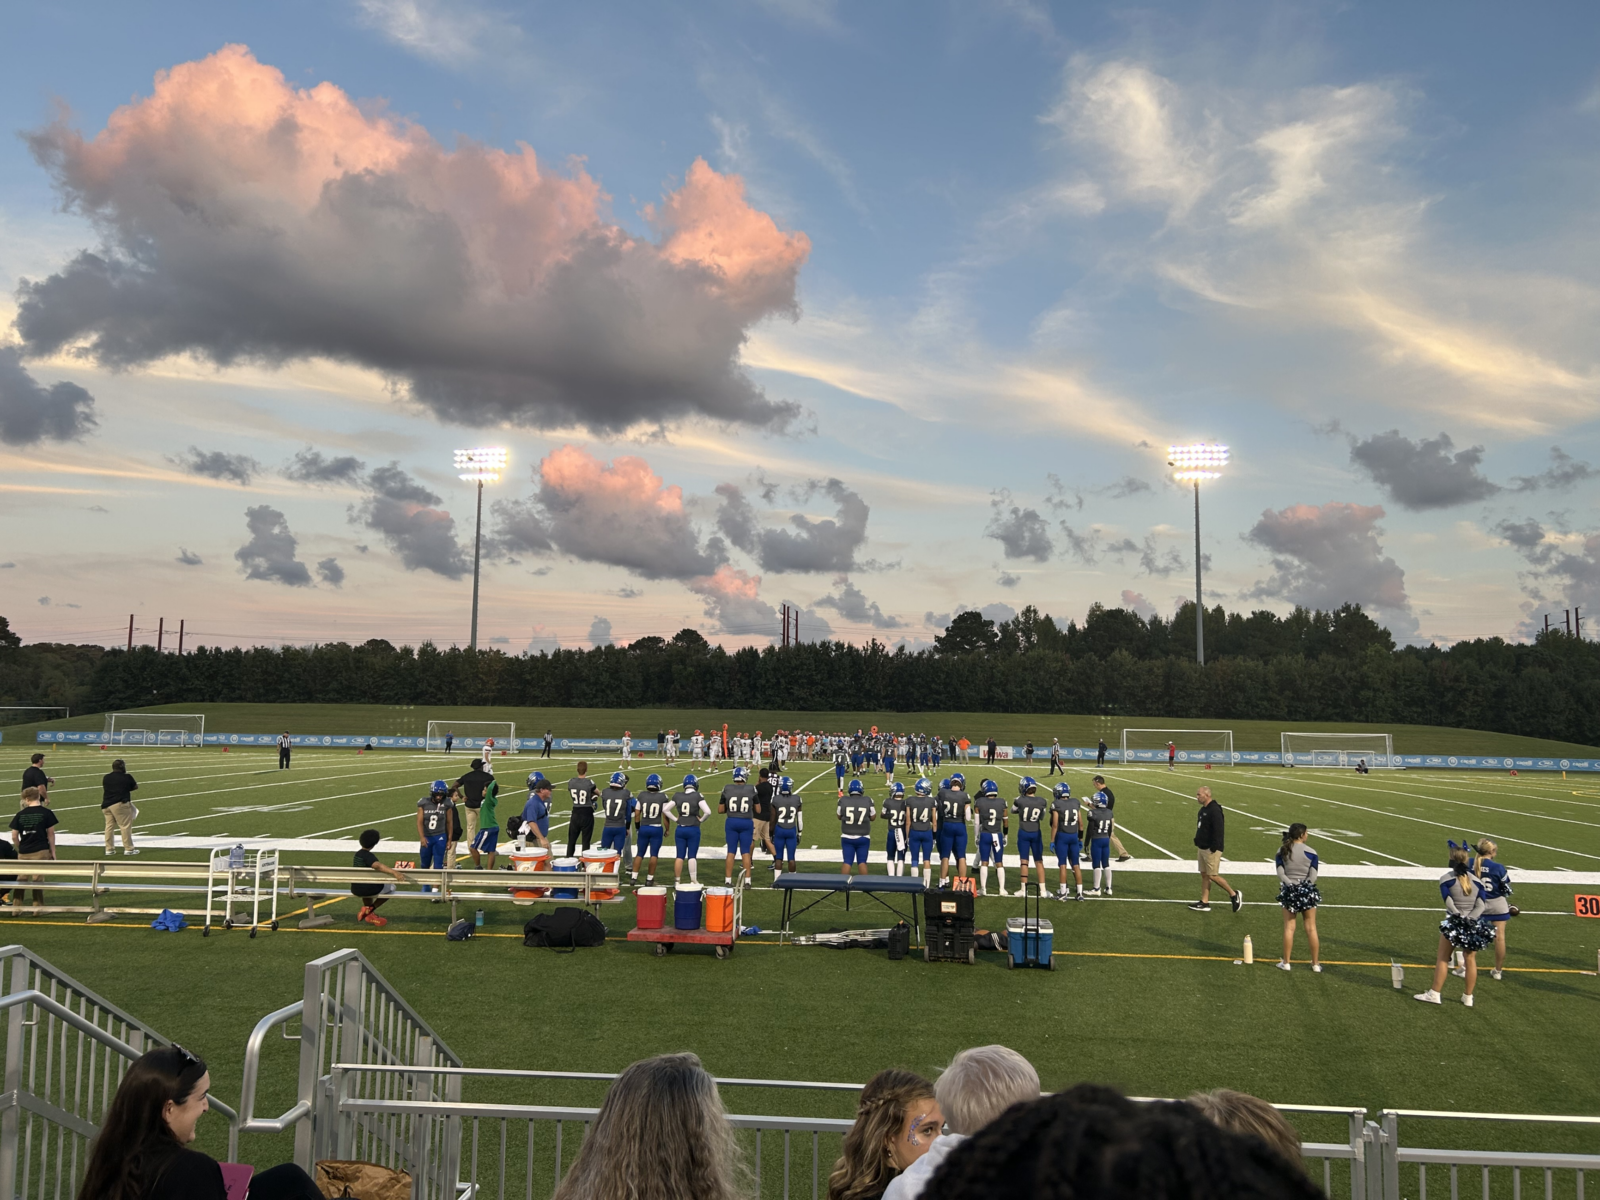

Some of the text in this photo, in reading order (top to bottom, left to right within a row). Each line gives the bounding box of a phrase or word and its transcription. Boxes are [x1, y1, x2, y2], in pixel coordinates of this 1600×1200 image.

[570, 789, 587, 805] 58
[728, 796, 749, 813] 66
[606, 799, 622, 817] 17
[642, 803, 660, 819] 10
[682, 802, 690, 817] 9
[777, 806, 797, 823] 23
[845, 806, 867, 825] 57
[912, 807, 929, 823] 14
[944, 801, 958, 819] 21
[1022, 806, 1041, 822] 18
[428, 814, 438, 830] 8
[890, 809, 905, 826] 20
[987, 808, 997, 826] 3
[1064, 809, 1078, 826] 13
[1577, 896, 1599, 916] 30
